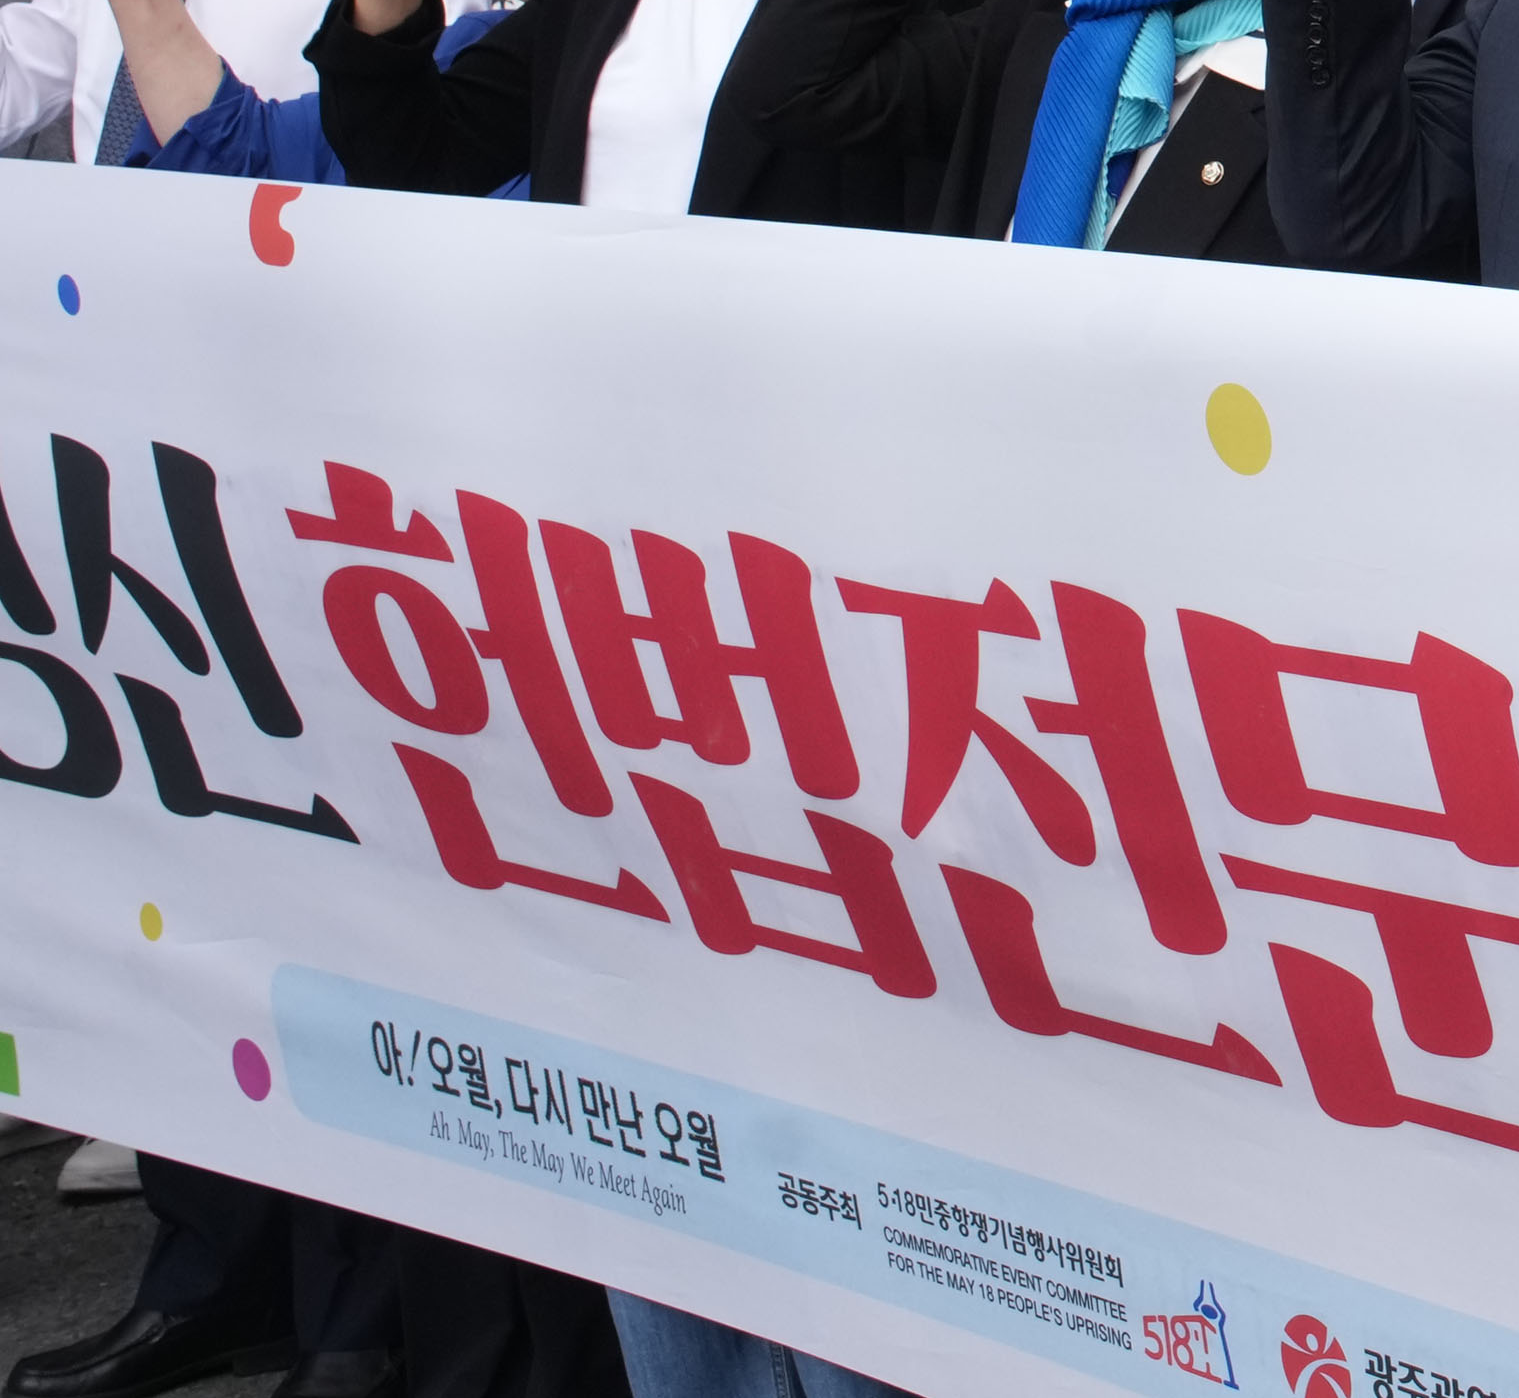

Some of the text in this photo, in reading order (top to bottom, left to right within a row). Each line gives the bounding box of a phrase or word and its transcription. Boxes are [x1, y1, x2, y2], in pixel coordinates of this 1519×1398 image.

[370, 1019, 726, 1184] 아! 오월, 다시 만난 오월
[429, 1110, 688, 1217] Ah May, The May We Meet Again
[777, 1170, 863, 1231] 공동주최
[882, 1224, 1128, 1324] COMMEMORATIVE EVENT COMMITTEE
[887, 1251, 1133, 1352] FOR THE MAY 18 PEOPLE'S UPRISING
